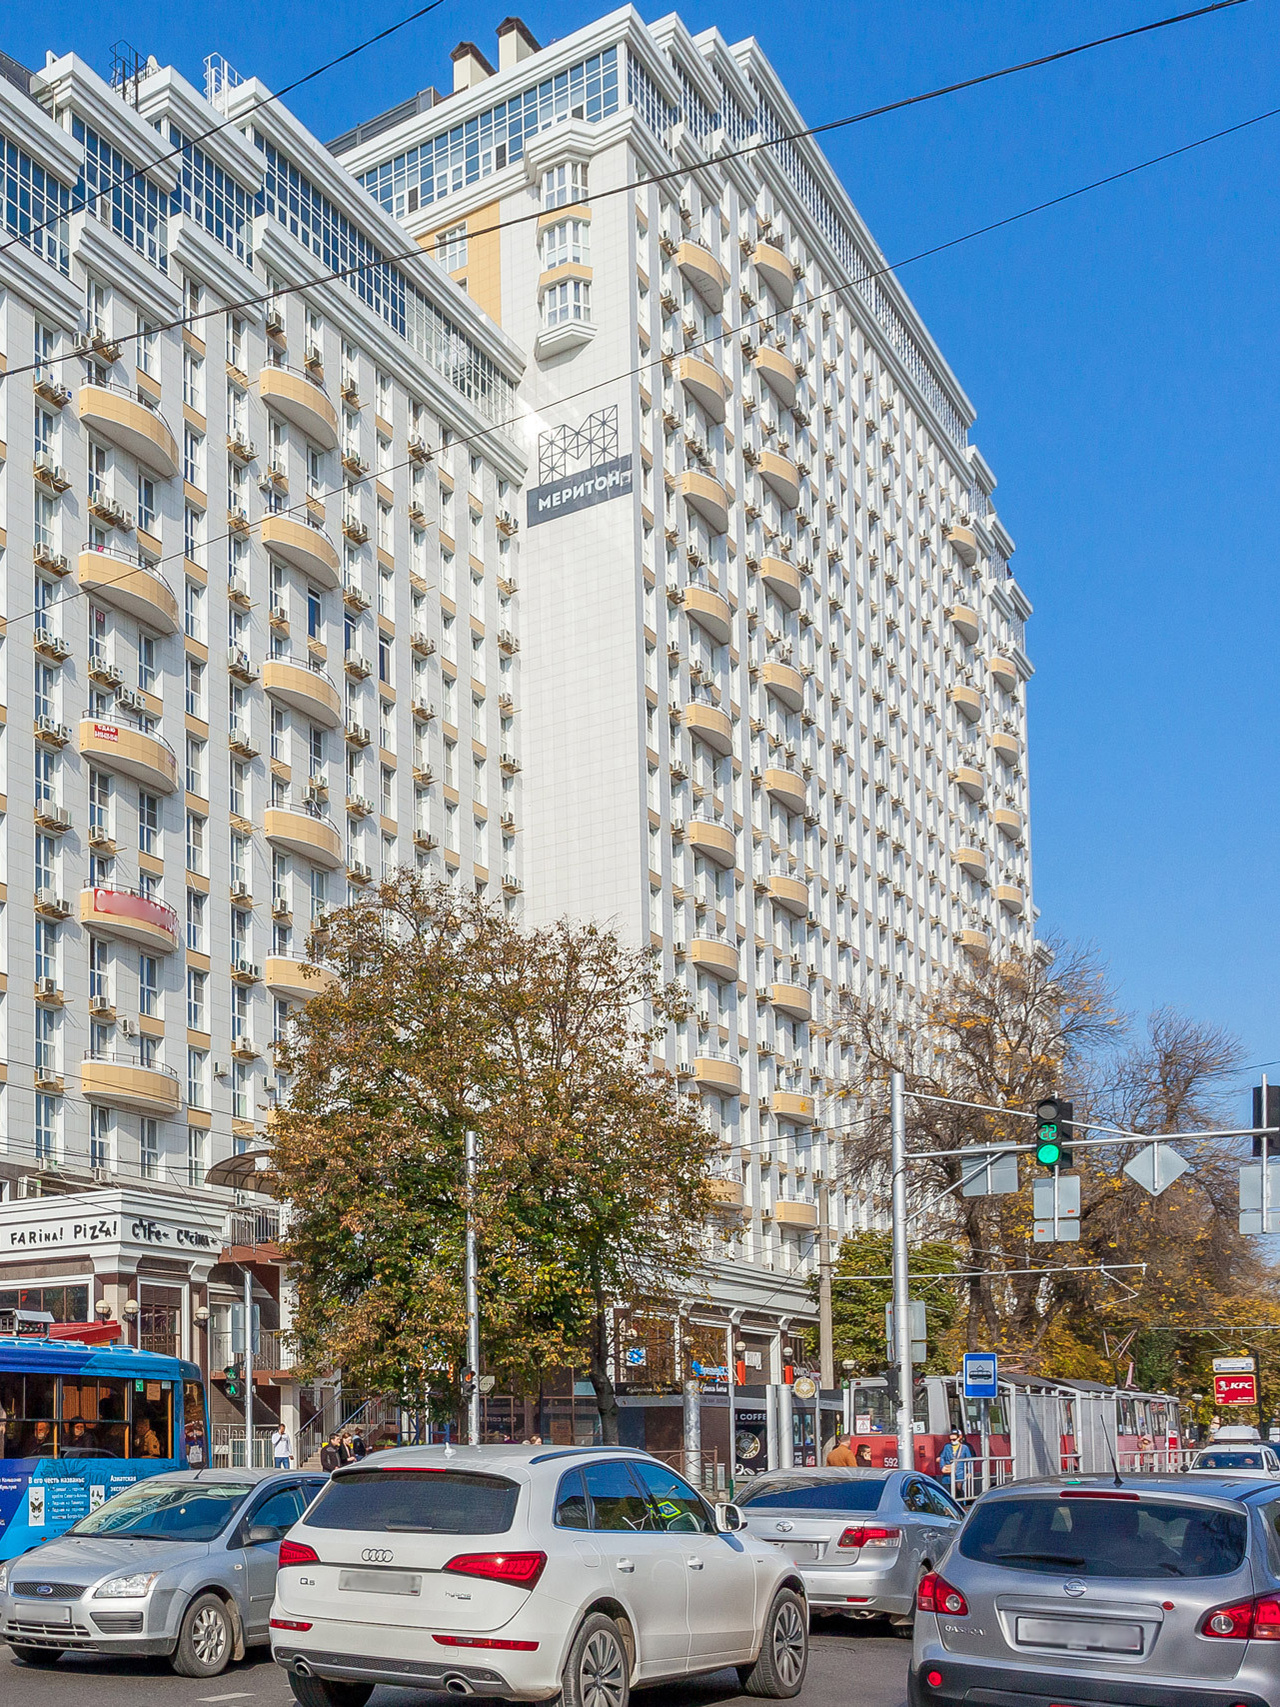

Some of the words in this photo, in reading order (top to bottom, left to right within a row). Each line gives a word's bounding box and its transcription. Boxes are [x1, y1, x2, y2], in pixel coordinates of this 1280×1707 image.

[1040, 1124, 1057, 1140] 22
[1230, 1382, 1253, 1390] KFC
[884, 1457, 899, 1467] 592
